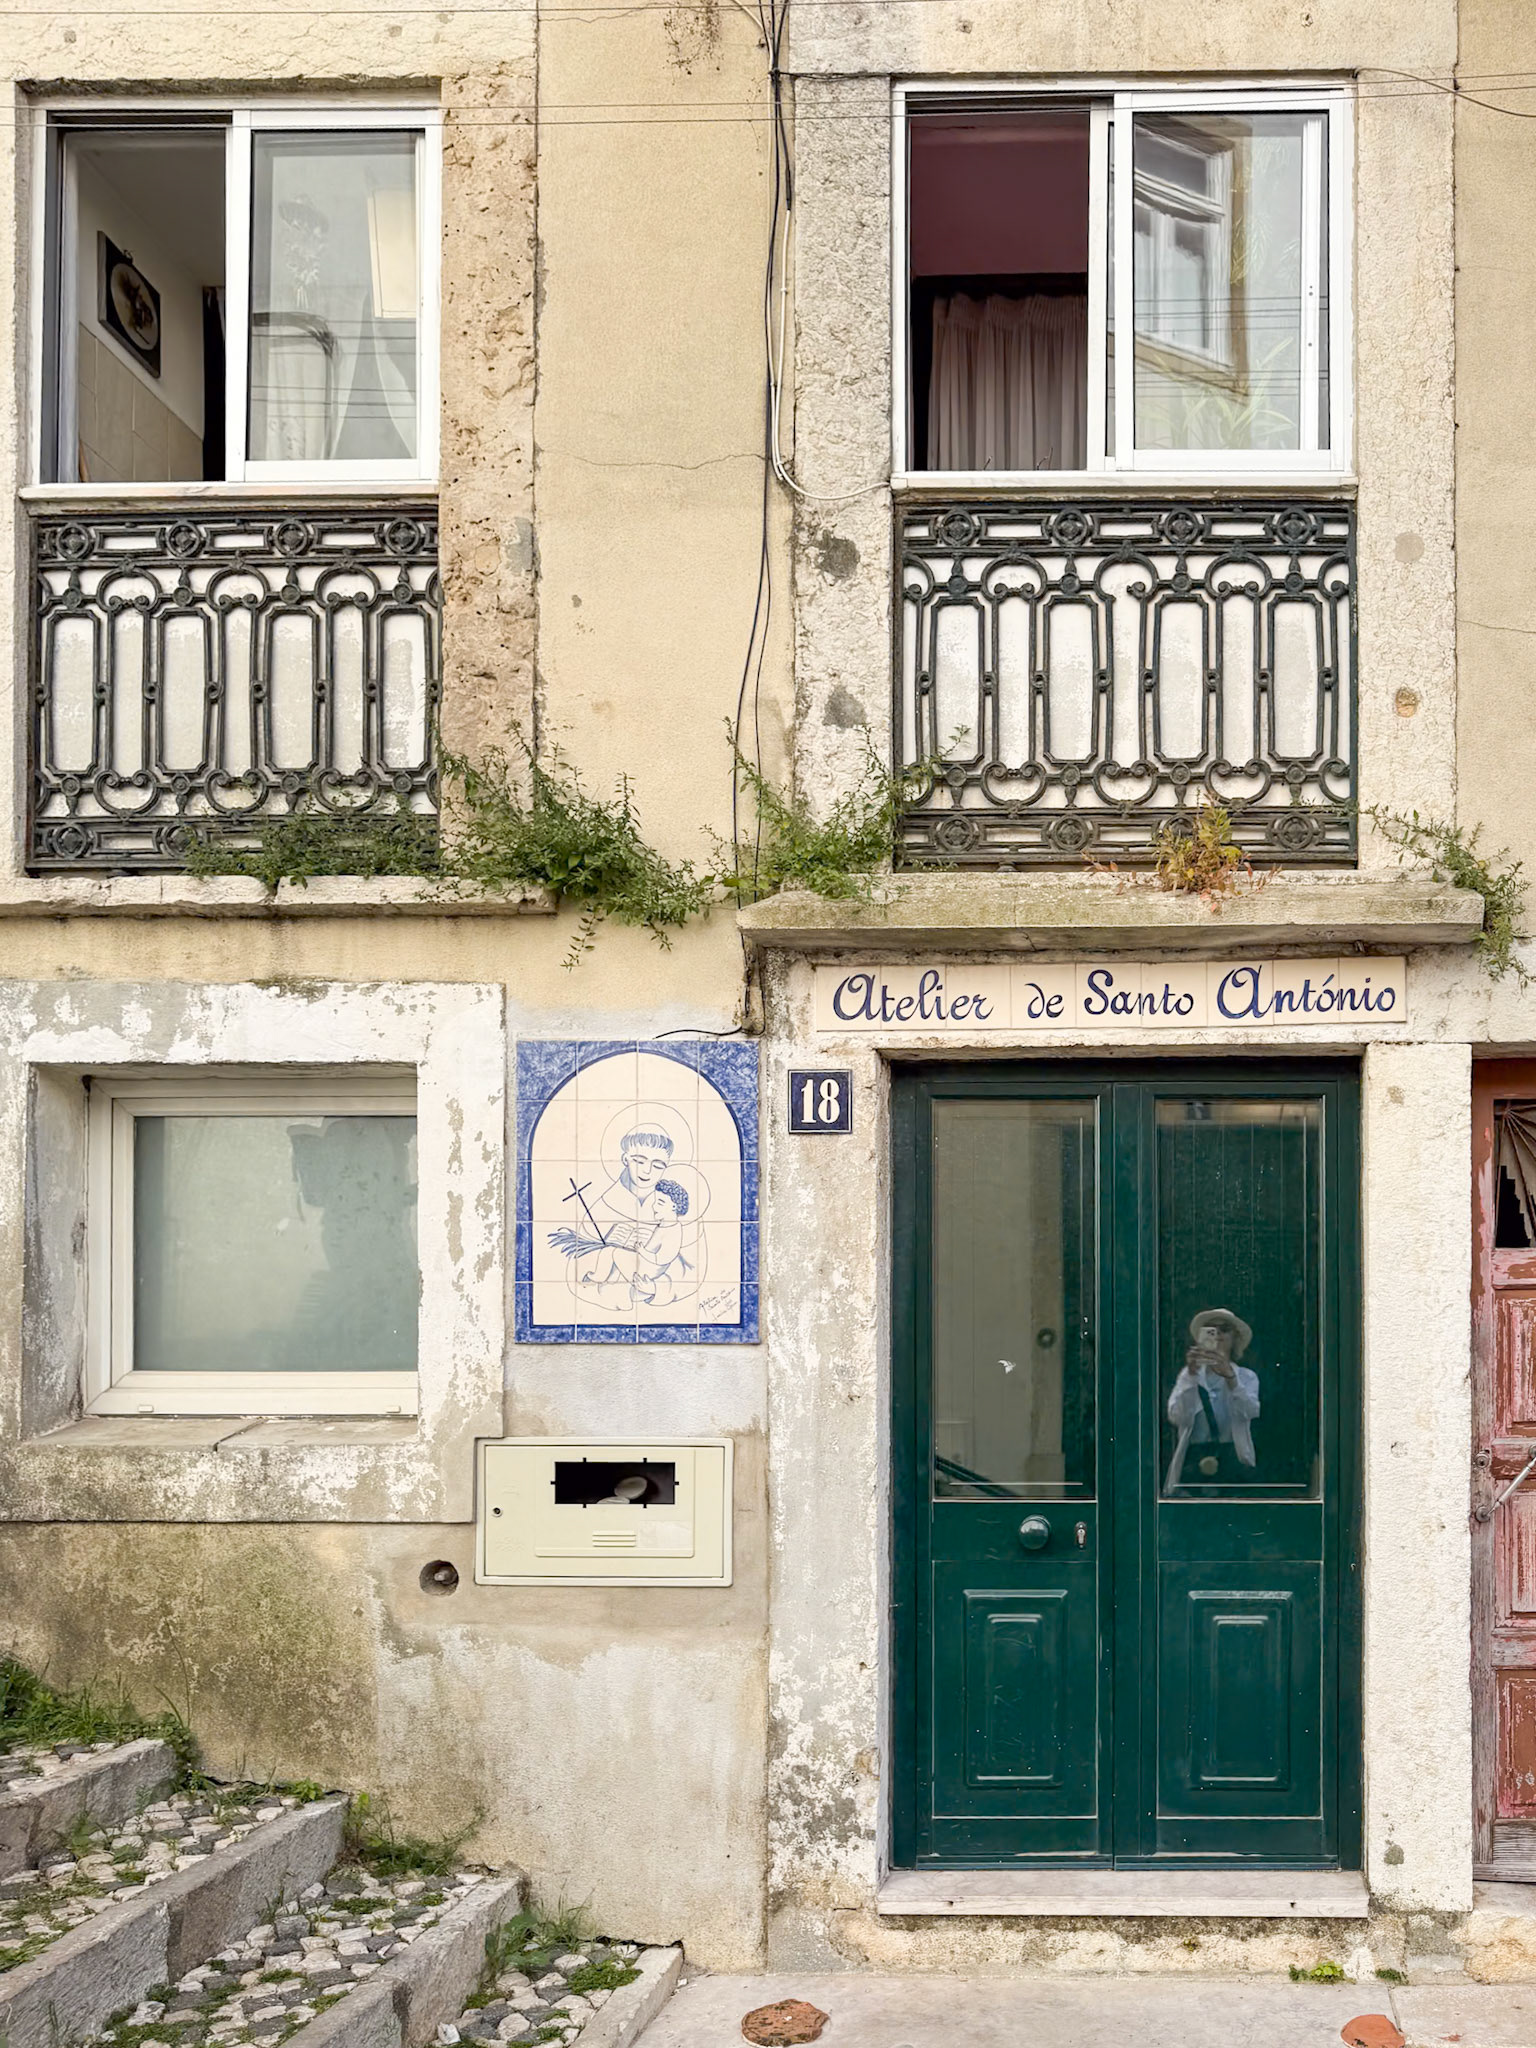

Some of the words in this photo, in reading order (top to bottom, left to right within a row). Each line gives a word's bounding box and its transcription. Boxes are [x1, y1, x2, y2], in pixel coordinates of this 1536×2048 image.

[832, 969, 994, 1023] Atelier
[1025, 982, 1064, 1019] de
[1083, 969, 1194, 1016] Santo
[1216, 964, 1396, 1020] António
[800, 1078, 840, 1124] 18
